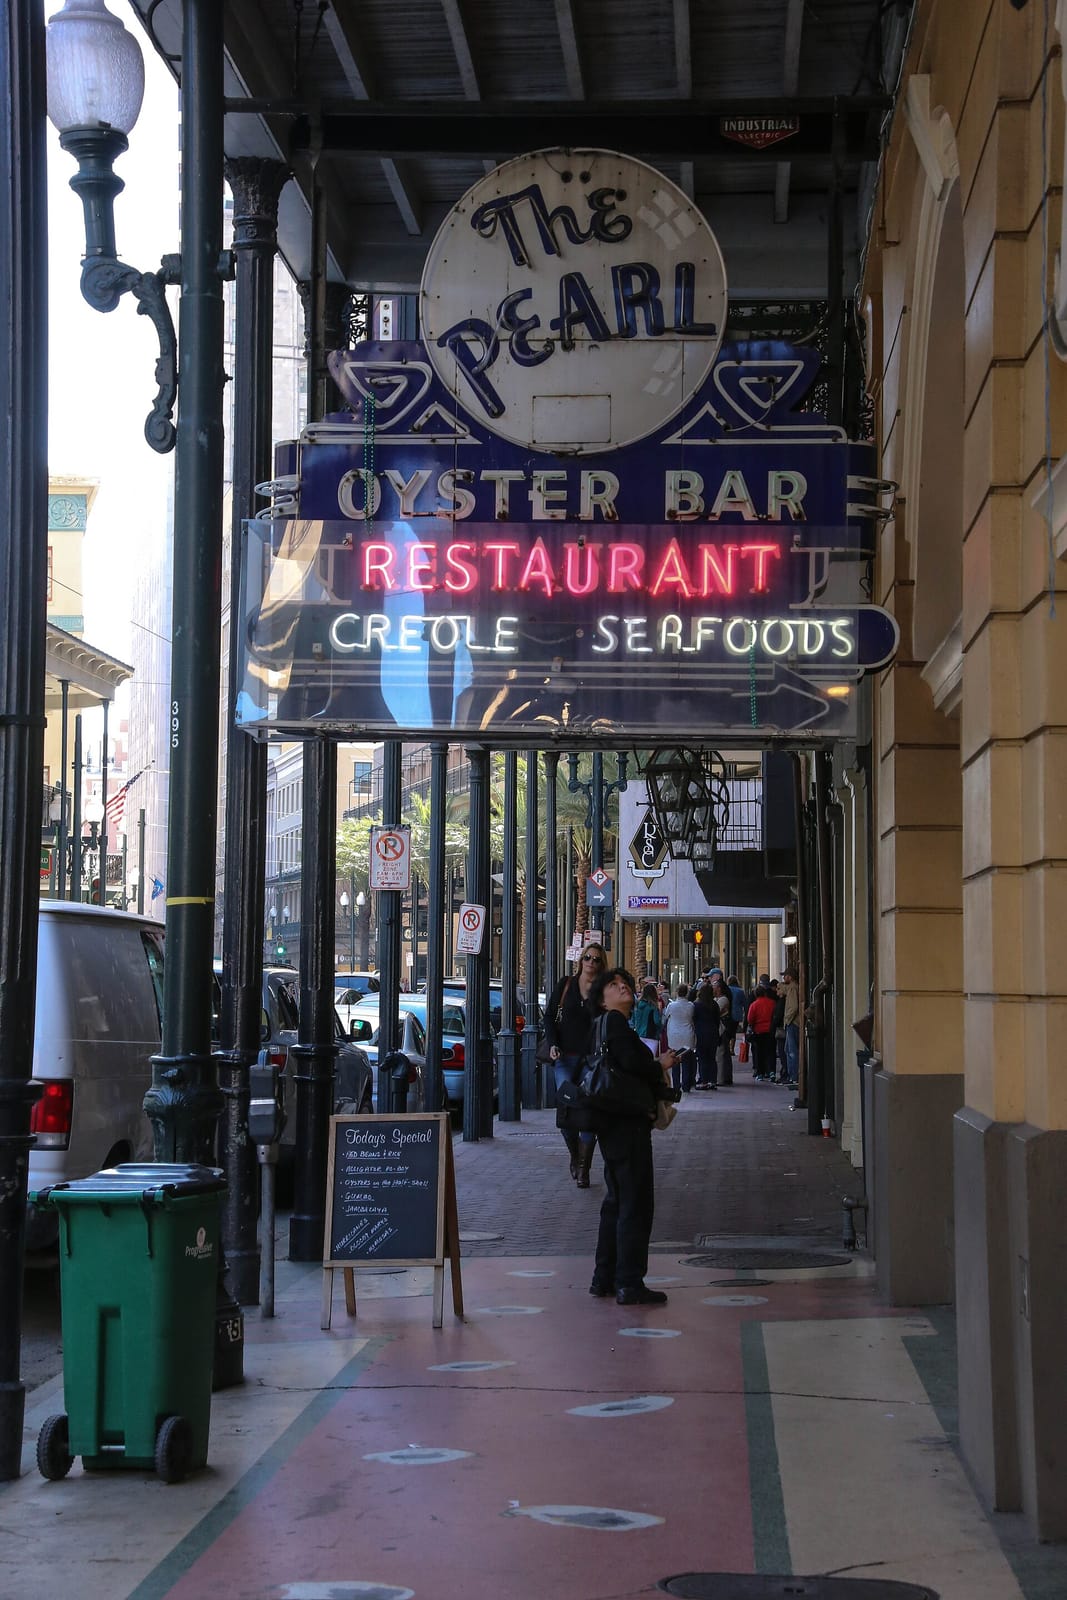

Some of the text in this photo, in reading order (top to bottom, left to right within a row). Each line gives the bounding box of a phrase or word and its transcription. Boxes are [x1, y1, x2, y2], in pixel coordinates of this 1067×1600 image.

[724, 119, 794, 131] INDUSTRIAL
[738, 132, 780, 140] ELECTRIC
[437, 262, 717, 419] PEARL
[337, 468, 808, 521] OYSTER BAR
[361, 537, 782, 599] RESTAURANT
[329, 612, 855, 656] CREOLE SEAFOODS
[641, 897, 668, 905] COFFEE
[345, 1128, 432, 1148] Today's Special
